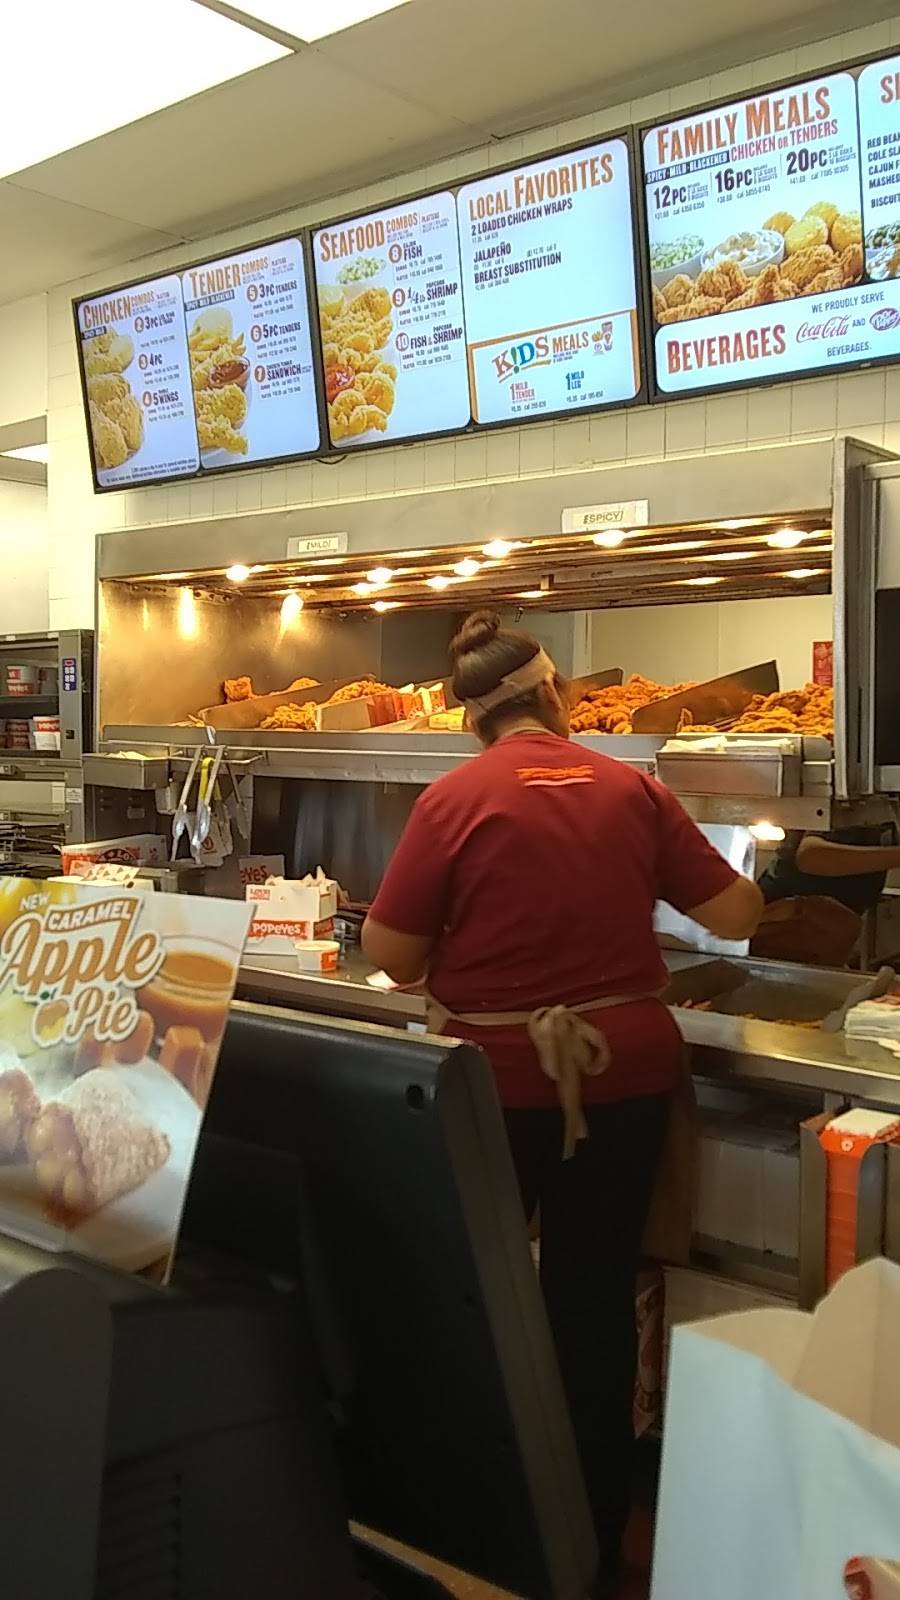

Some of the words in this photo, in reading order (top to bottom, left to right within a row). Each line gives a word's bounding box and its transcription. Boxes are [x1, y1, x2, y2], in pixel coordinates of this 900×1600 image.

[657, 112, 738, 165] FAMILY
[745, 86, 830, 141] MEALS
[730, 135, 776, 162] CHICKEN
[790, 119, 839, 146] TENDERS
[867, 136, 881, 149] RED
[867, 149, 887, 162] COLE
[868, 161, 894, 176] CAJUN
[469, 189, 512, 222] LOCAL
[513, 153, 614, 212] FAVORITES
[471, 225, 477, 237] 2
[478, 216, 506, 234] LOADED
[507, 207, 543, 226] CHICKEN
[544, 198, 573, 215] WRAPS
[319, 219, 385, 262] SEAFOOD
[386, 212, 418, 233] COMBOS
[404, 244, 423, 261] FISH
[473, 241, 512, 263] JALAPEÑO
[189, 263, 241, 298] TENDER
[241, 256, 269, 275] COMBOS
[474, 266, 503, 284] BREAST
[504, 252, 562, 276] SUBSTITUTION
[275, 280, 298, 294] TENDERS
[426, 282, 458, 301] SHRIMP
[83, 295, 132, 329] CHICKEN
[811, 303, 823, 314] WE
[824, 296, 859, 312] PROUDLY
[860, 292, 885, 305] SERVE
[279, 321, 301, 336] TENDERS
[852, 318, 866, 328] AND
[410, 335, 428, 350] FISH
[433, 327, 463, 345] SHRIMP
[552, 331, 589, 354] MEALS
[667, 324, 787, 375] BEVERAGES
[267, 363, 302, 381] SANDWICH
[516, 388, 535, 398] TENDER
[571, 380, 582, 390] LEG
[153, 392, 159, 406] 5
[159, 391, 179, 405] WINGS
[19, 891, 50, 911] NEW
[48, 900, 132, 930] CARAMEL
[3, 918, 163, 996] Apple
[66, 986, 137, 1036] Pie
